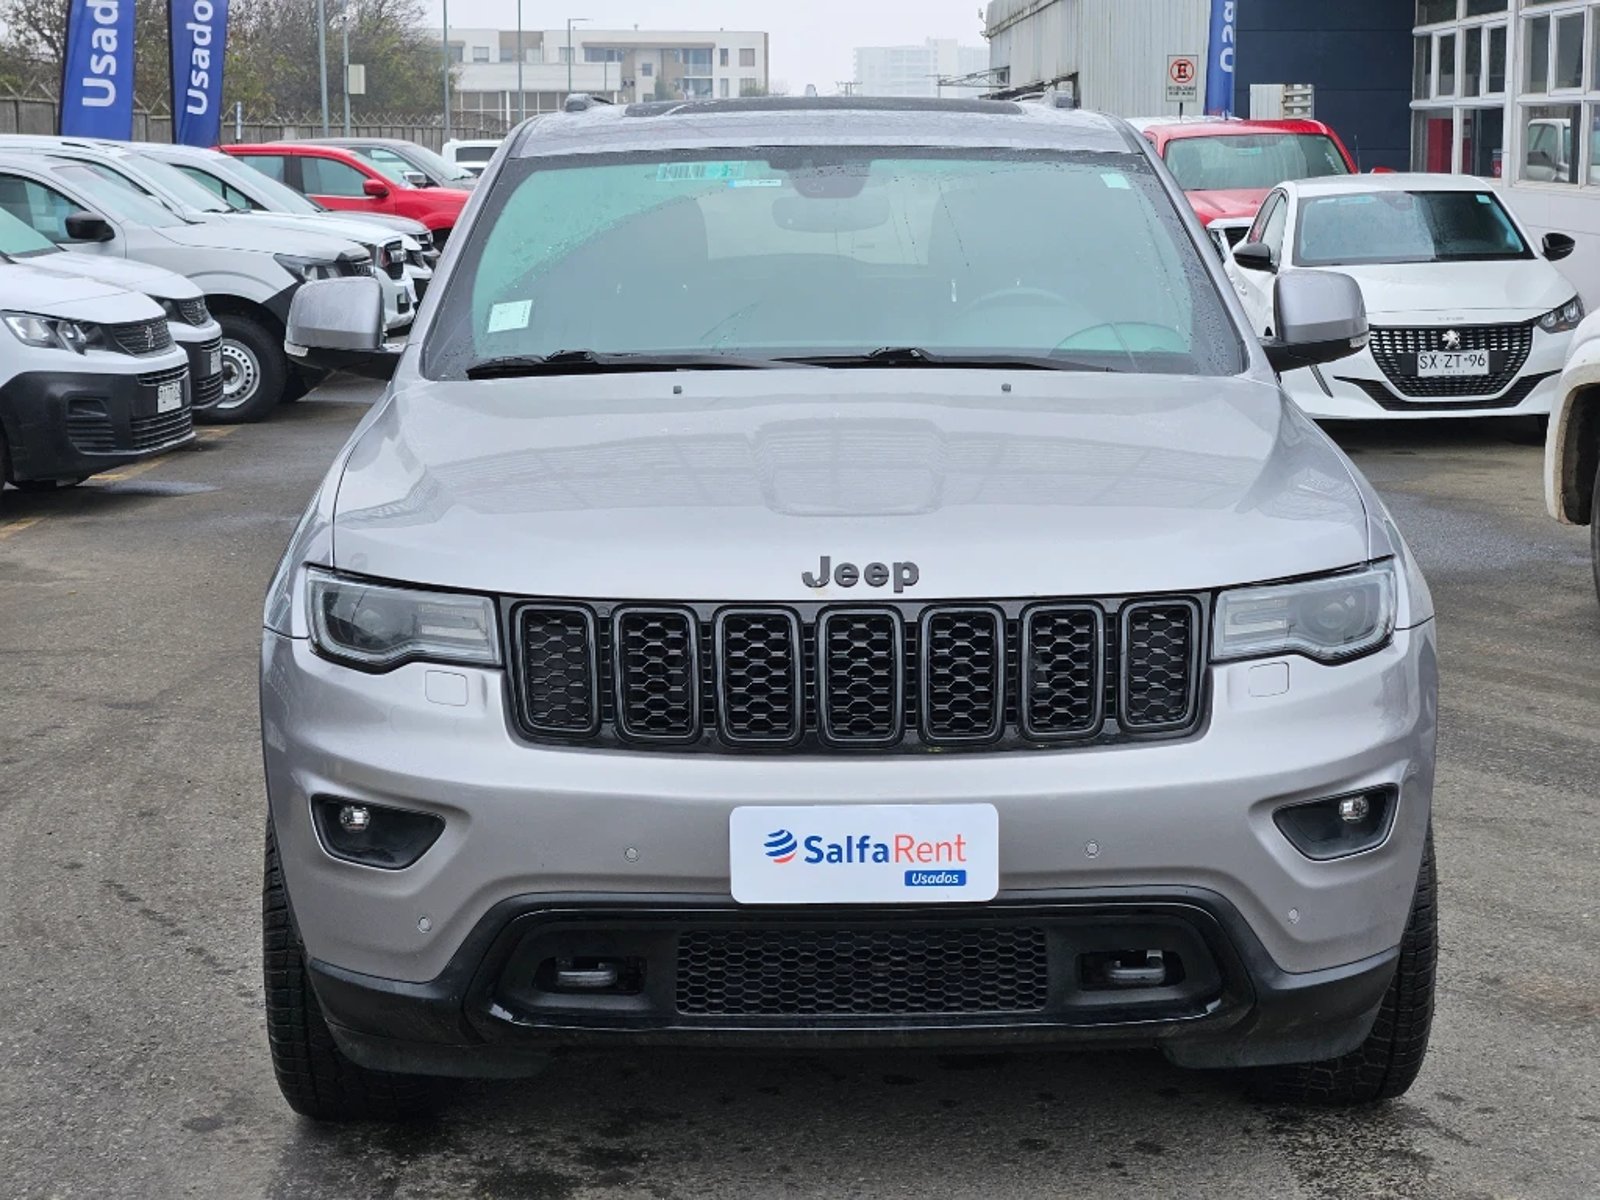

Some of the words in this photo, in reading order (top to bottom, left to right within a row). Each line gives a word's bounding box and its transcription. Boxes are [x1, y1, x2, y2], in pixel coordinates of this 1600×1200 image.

[82, 0, 119, 107] Usad
[186, 0, 214, 115] Usado
[802, 555, 919, 593] Jeep
[804, 834, 967, 864] SalfaRent
[911, 871, 959, 884] Usados
